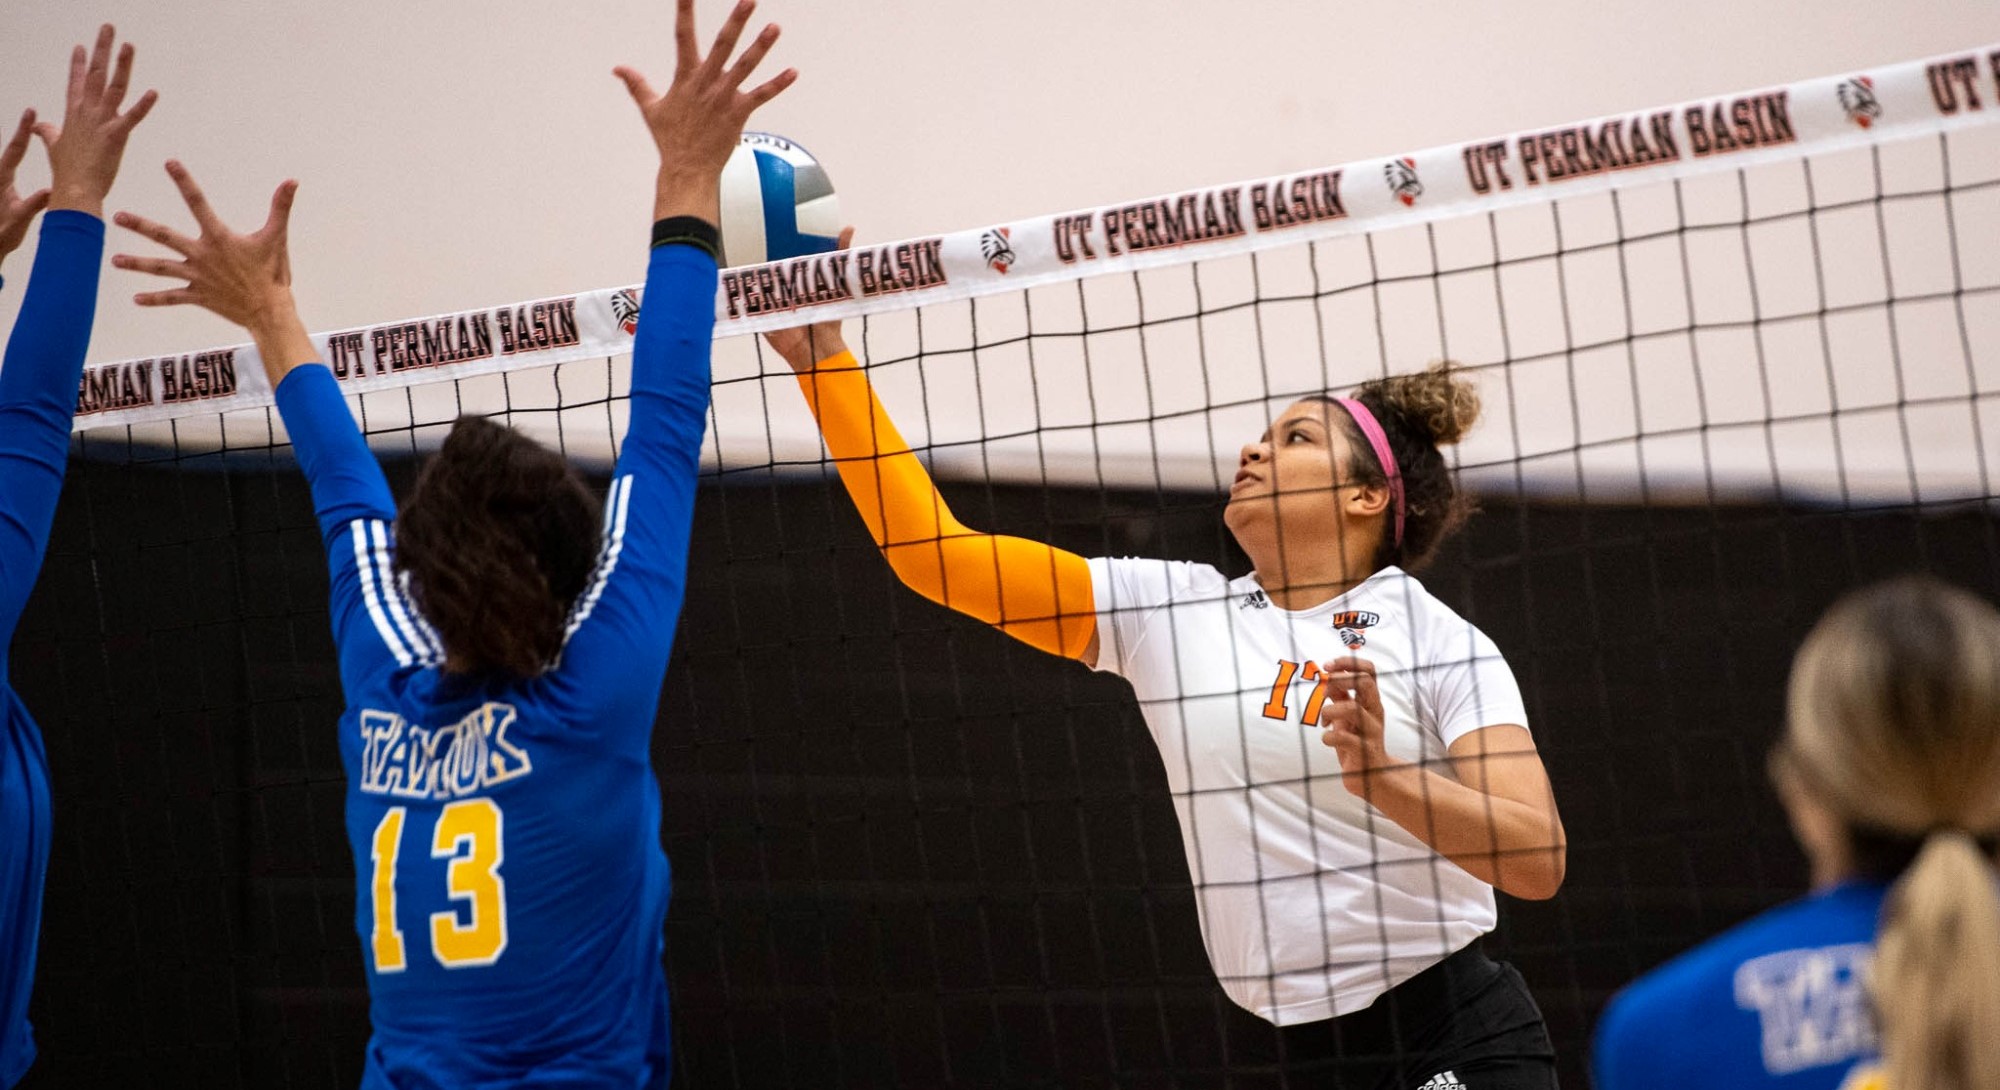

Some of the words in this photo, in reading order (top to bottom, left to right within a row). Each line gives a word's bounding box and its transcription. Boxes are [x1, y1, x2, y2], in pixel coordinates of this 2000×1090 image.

[1926, 57, 1983, 116] UT
[1463, 139, 1512, 194] UT
[1518, 111, 1680, 186] PERMIAN
[1684, 90, 1795, 157] BASIN
[1053, 213, 1097, 264] UT
[1101, 187, 1247, 257] PERMIAN
[1250, 169, 1348, 233] BASIN
[723, 253, 854, 319] PERMIAN
[857, 239, 947, 297] BASIN
[328, 331, 366, 380] UT
[371, 310, 493, 376] PERMIAN
[496, 297, 580, 355] BASIN
[75, 358, 154, 416] RMIAN
[160, 348, 237, 404] BASIN
[1333, 611, 1379, 627] UTPB
[1262, 659, 1329, 727] 17
[371, 797, 508, 973] 13
